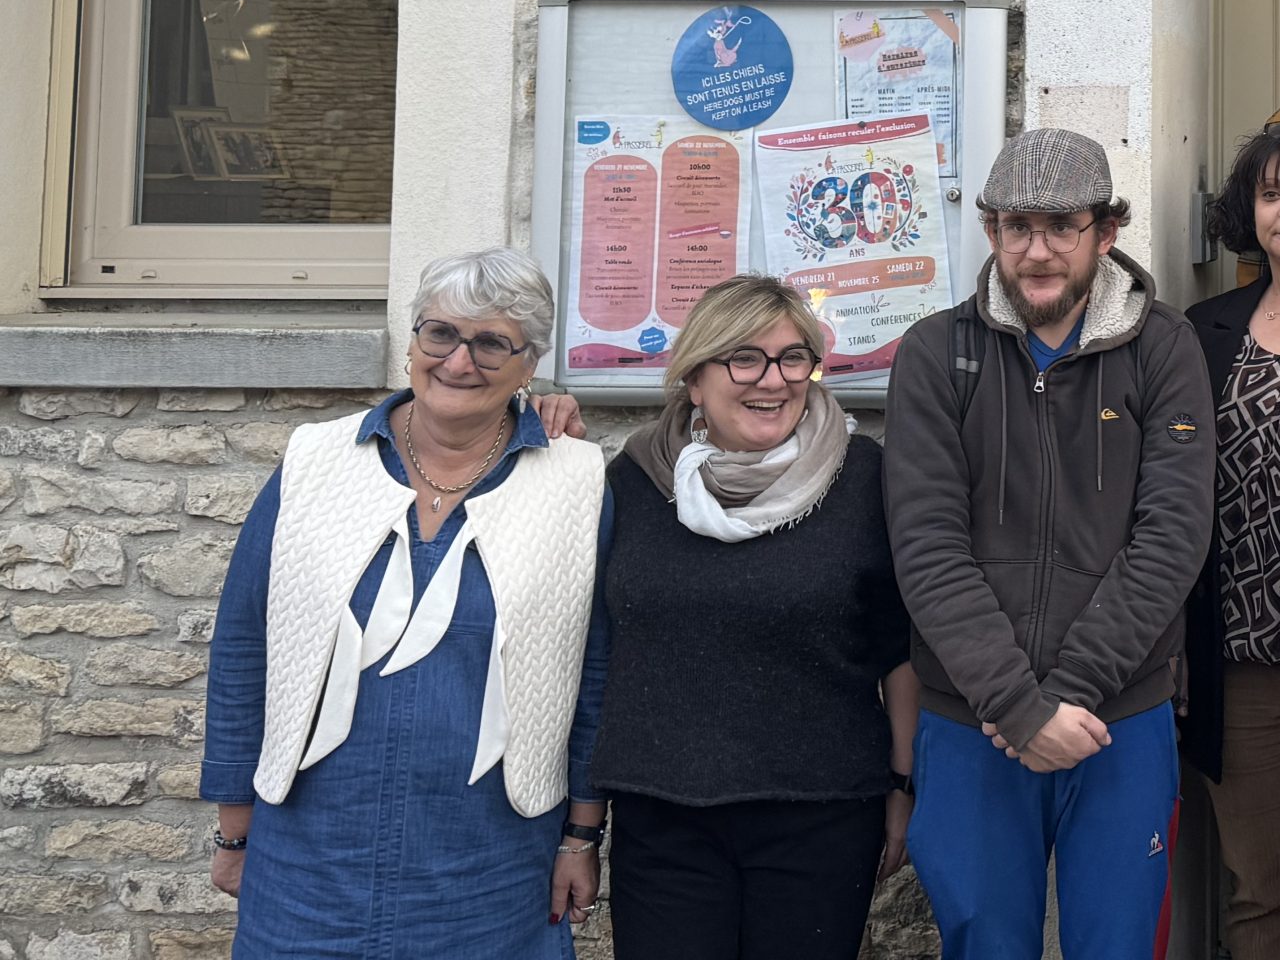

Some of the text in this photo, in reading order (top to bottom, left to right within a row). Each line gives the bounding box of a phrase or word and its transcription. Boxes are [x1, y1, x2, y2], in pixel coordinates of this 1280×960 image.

[702, 64, 765, 88] ICI LES CHIENS
[687, 72, 787, 105] SONT TENUS EN LAISSE
[704, 88, 775, 112] HERE DOGS MUST BE
[712, 99, 772, 120] KEPT ON A LEASH
[778, 122, 916, 145] Ensemble faisons reculer l'exclusion
[811, 172, 898, 248] 30
[850, 248, 865, 258] ANS
[886, 261, 925, 274] SAMEDI 22
[791, 272, 835, 286] VENDREDI 21
[838, 277, 869, 288] NOVEMBRE
[872, 275, 880, 283] 25
[835, 304, 880, 318] ANIMATIONS
[871, 312, 921, 327] CONFÉRENCES
[848, 335, 876, 346] STANDS
